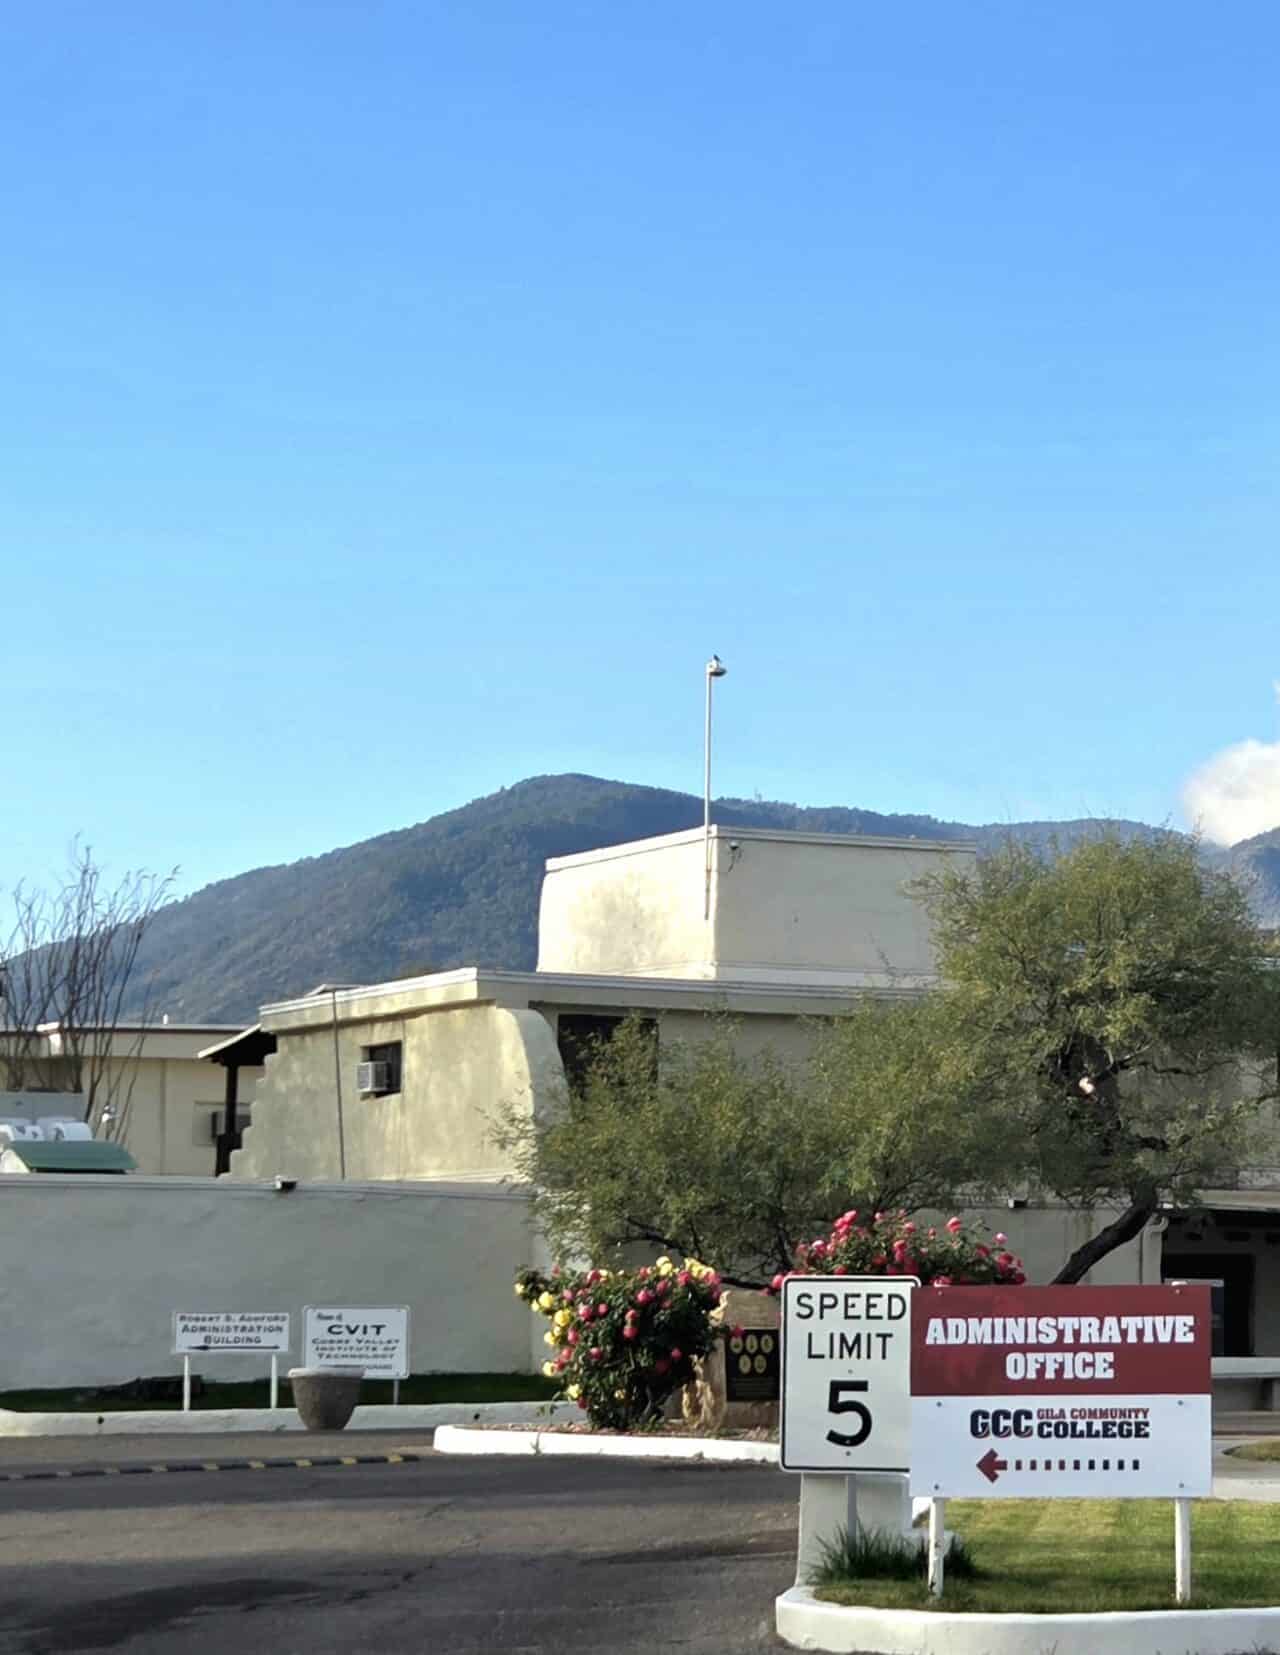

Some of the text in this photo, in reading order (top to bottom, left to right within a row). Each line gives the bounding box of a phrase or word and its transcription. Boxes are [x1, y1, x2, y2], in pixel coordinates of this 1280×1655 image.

[795, 1293, 907, 1321] SPEED
[181, 1324, 284, 1334] ADMINISTRATION
[203, 1335, 262, 1345] BUILDING
[327, 1324, 387, 1336] CVIT
[925, 1315, 1196, 1345] ADMINISTRATIVE
[807, 1332, 894, 1360] LIMIT
[1005, 1351, 1115, 1381] OFFICE
[826, 1380, 873, 1447] 5
[969, 1408, 1034, 1439] GCC
[1036, 1407, 1150, 1420] GILA COMMUNITY
[1037, 1420, 1150, 1439] COLLEGE
